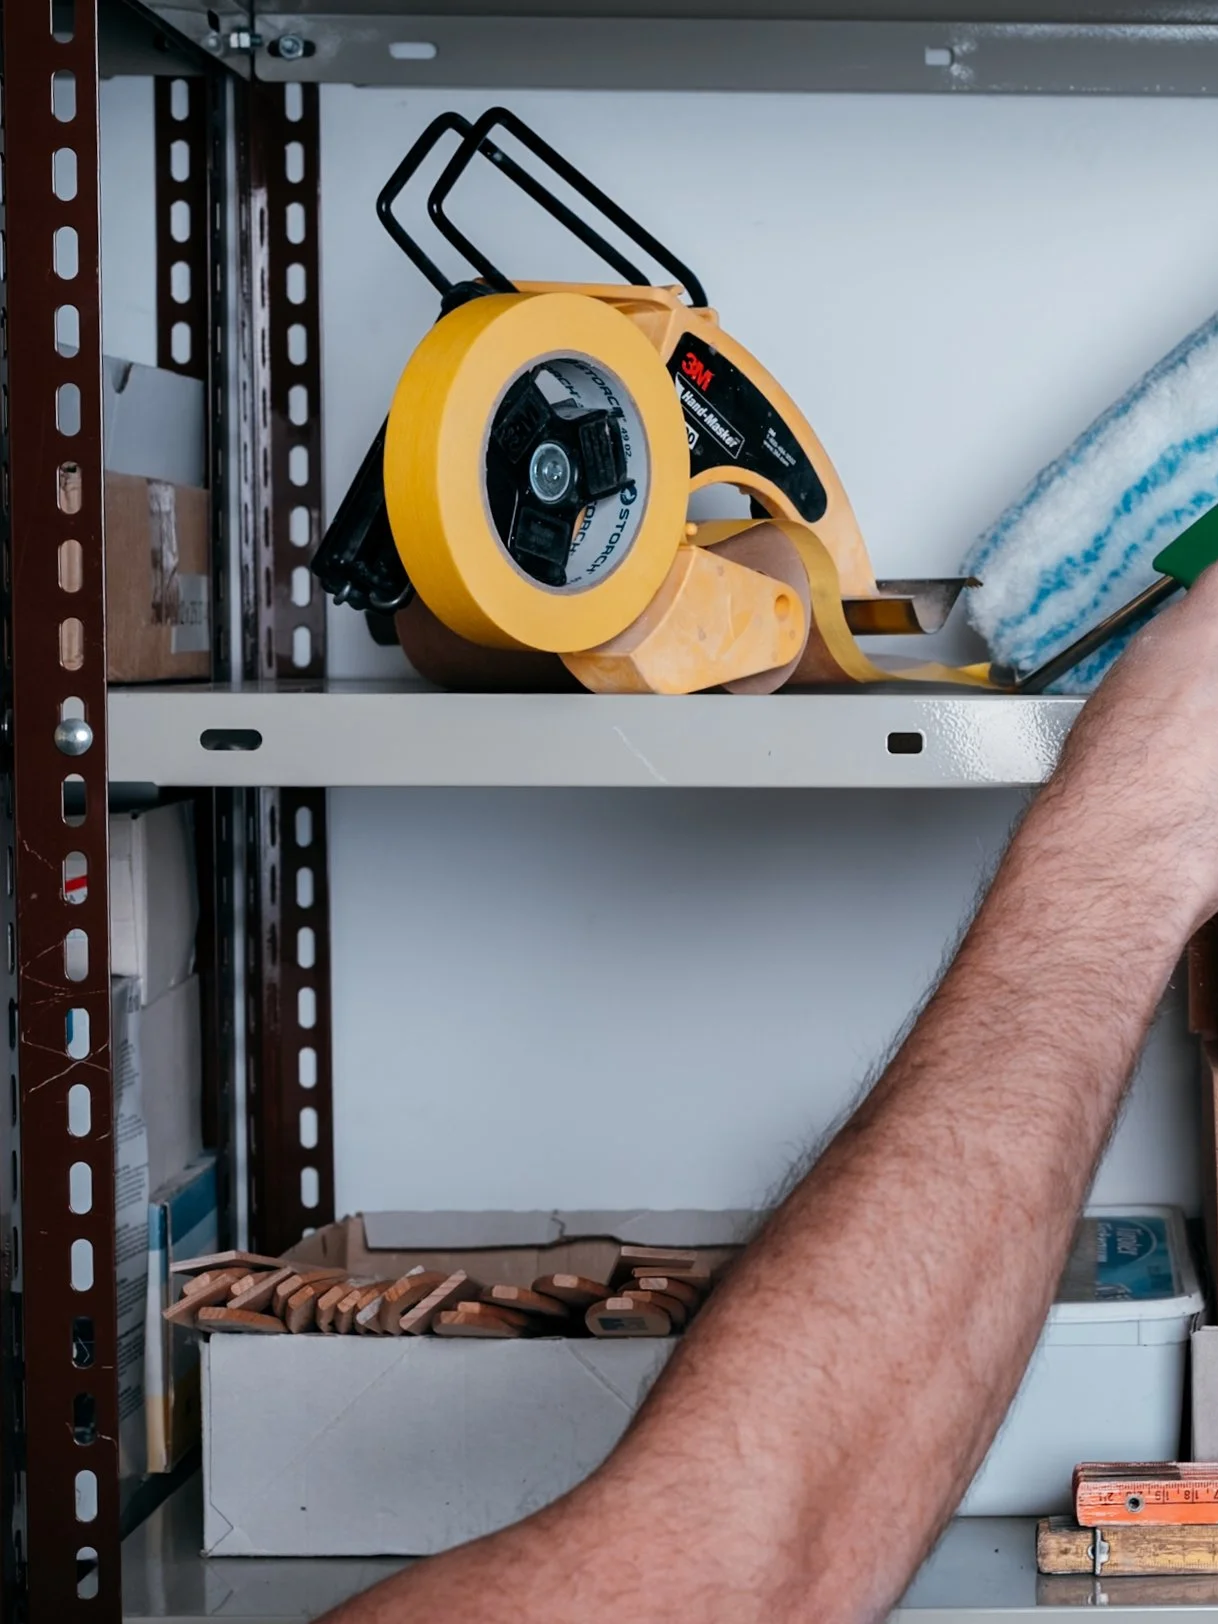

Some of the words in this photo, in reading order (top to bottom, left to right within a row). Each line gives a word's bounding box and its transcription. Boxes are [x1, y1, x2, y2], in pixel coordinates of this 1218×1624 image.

[681, 352, 714, 391] 3M
[682, 390, 739, 448] Hand-Masker
[586, 508, 630, 575] STORCH
